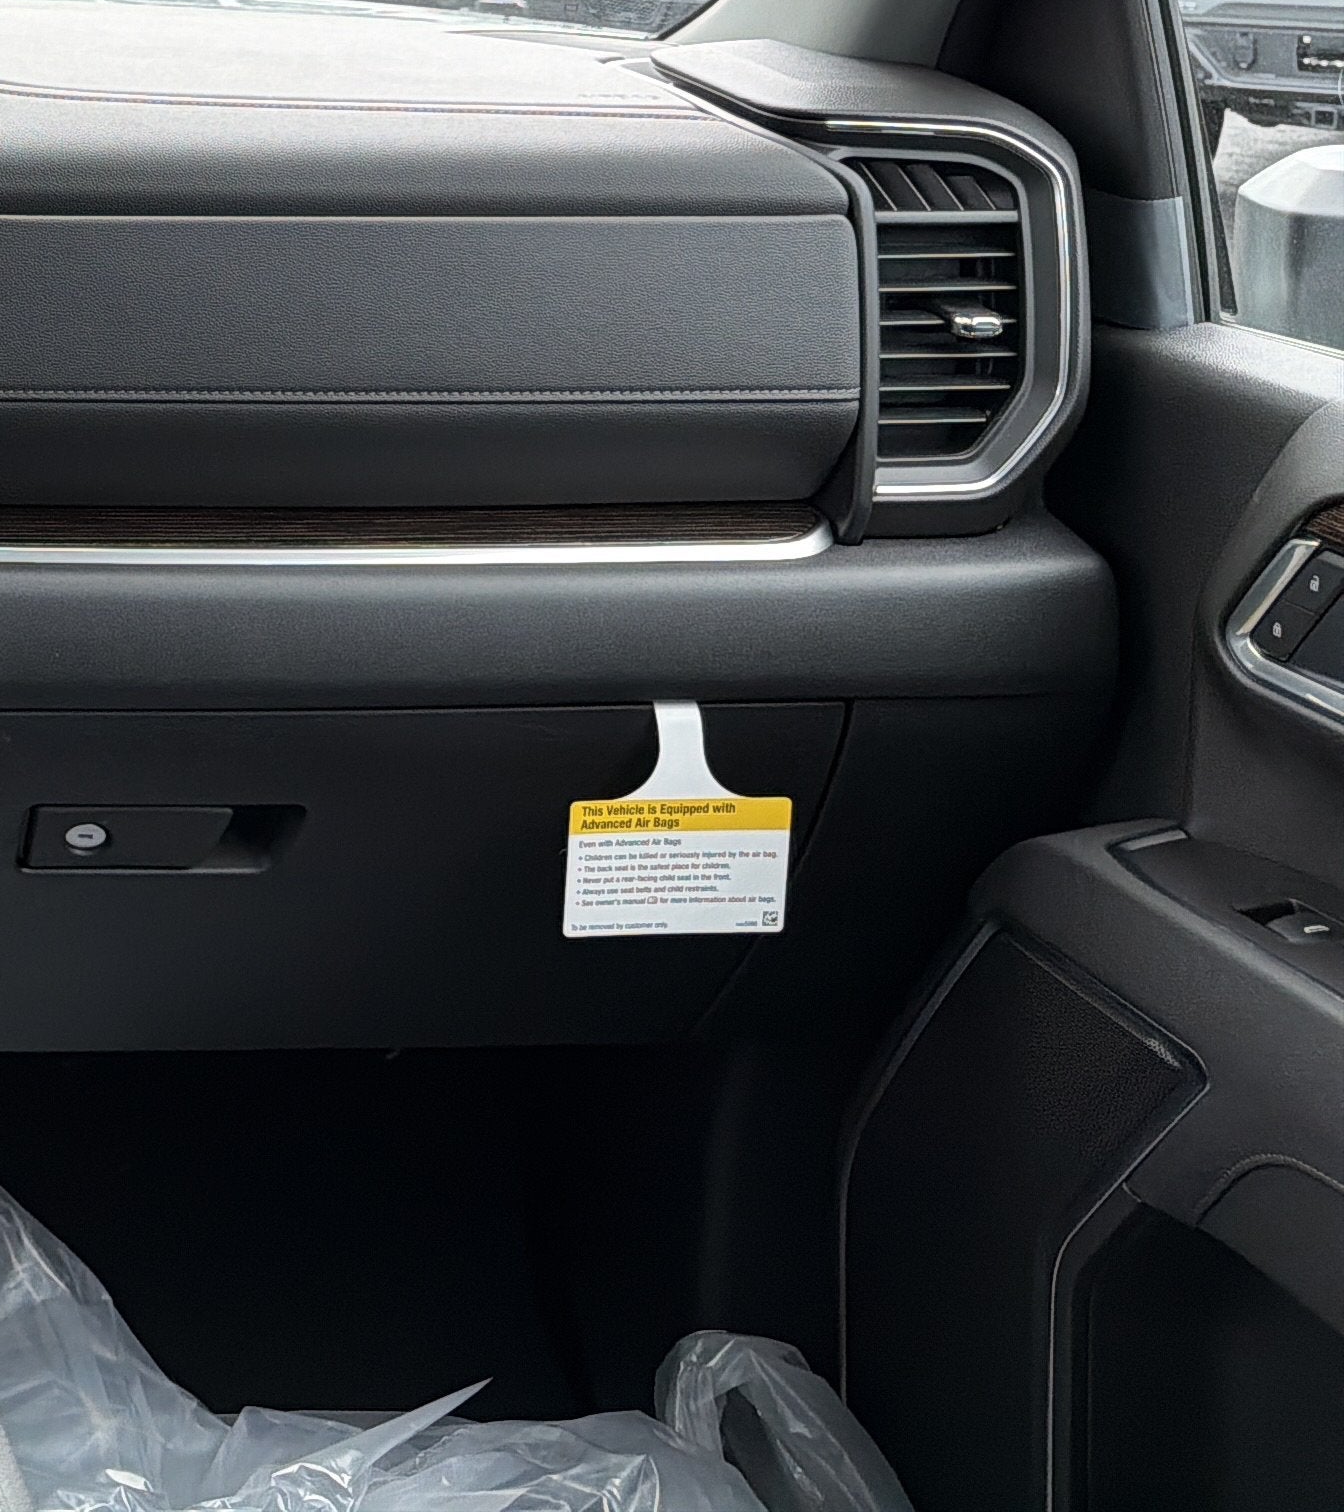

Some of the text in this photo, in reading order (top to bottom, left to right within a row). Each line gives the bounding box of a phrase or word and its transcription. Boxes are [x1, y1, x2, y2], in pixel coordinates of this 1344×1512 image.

[581, 802, 736, 817] This Vehicle is Equipped with
[580, 817, 680, 830] Advanced Air Bags
